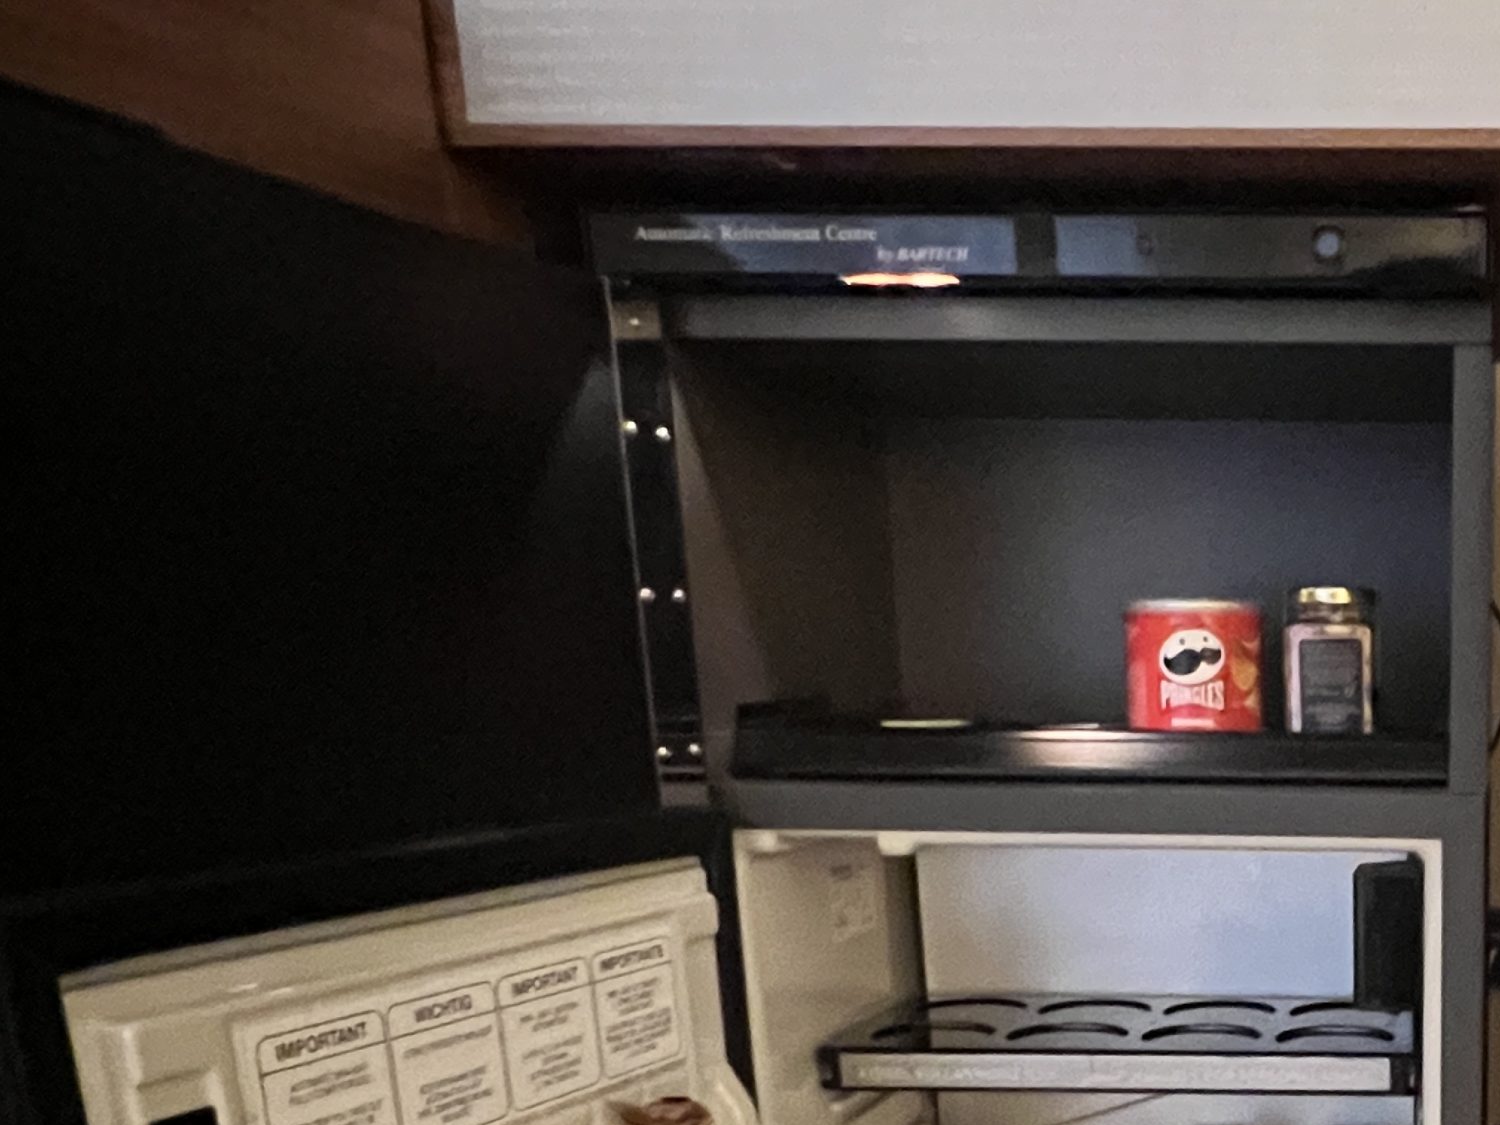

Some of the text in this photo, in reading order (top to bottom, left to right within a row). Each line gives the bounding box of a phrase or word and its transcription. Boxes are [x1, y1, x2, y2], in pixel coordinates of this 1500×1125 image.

[720, 225, 821, 241] Refreshment
[825, 224, 878, 241] Centre
[1159, 679, 1225, 711] PRINGLES
[274, 1021, 368, 1062] IMPORTANT
